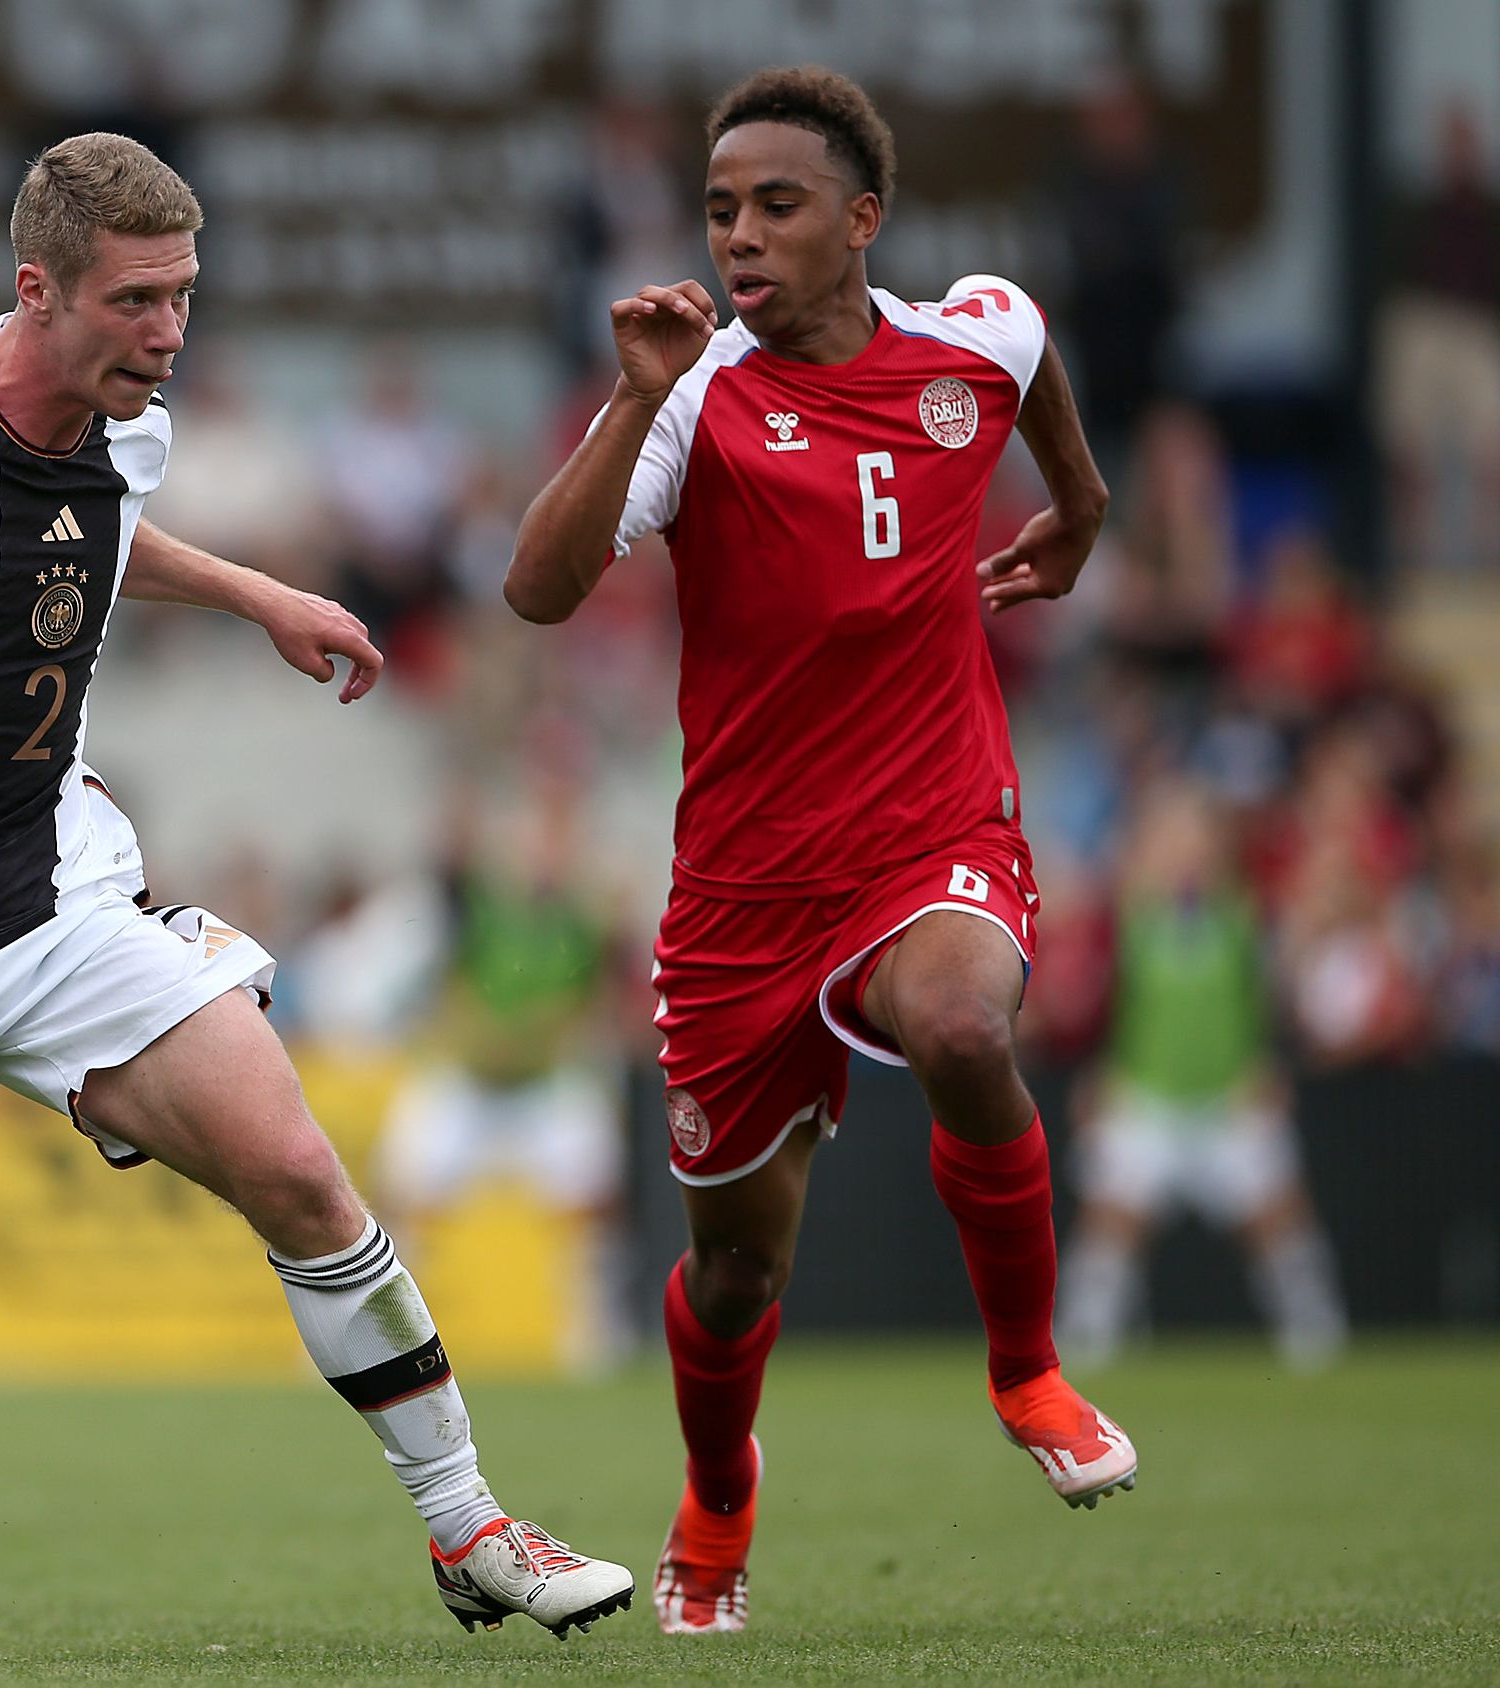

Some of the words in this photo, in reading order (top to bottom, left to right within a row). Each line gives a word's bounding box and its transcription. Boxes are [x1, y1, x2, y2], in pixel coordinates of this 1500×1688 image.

[931, 400, 965, 424] DBU
[764, 436, 810, 452] hummel
[855, 450, 901, 560] 6
[11, 664, 68, 761] 2
[947, 863, 990, 902] 6
